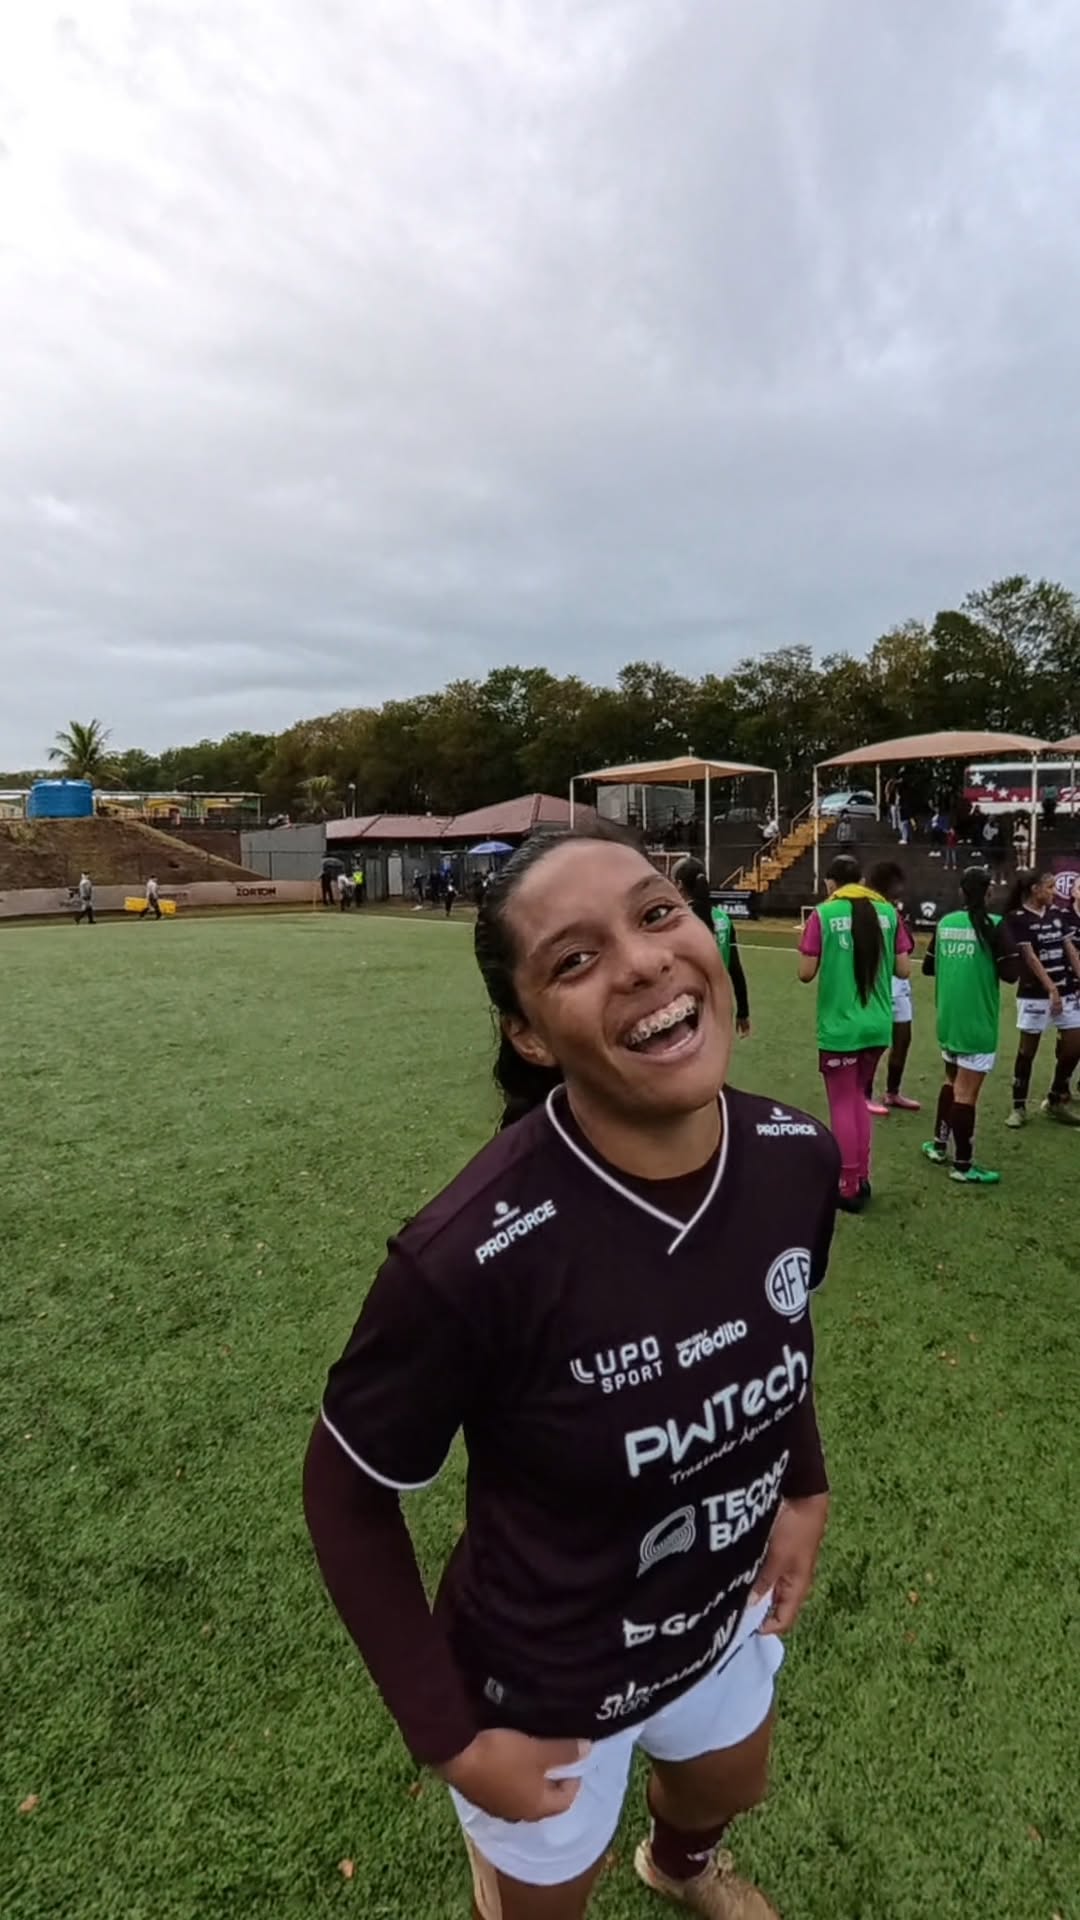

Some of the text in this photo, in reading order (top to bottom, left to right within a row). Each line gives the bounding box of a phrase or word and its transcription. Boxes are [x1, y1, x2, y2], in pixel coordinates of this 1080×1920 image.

[569, 1335, 661, 1385] LUPO
[601, 1360, 663, 1395] SPORT
[625, 1344, 808, 1479] PWTech
[701, 1449, 790, 1524] TECNO
